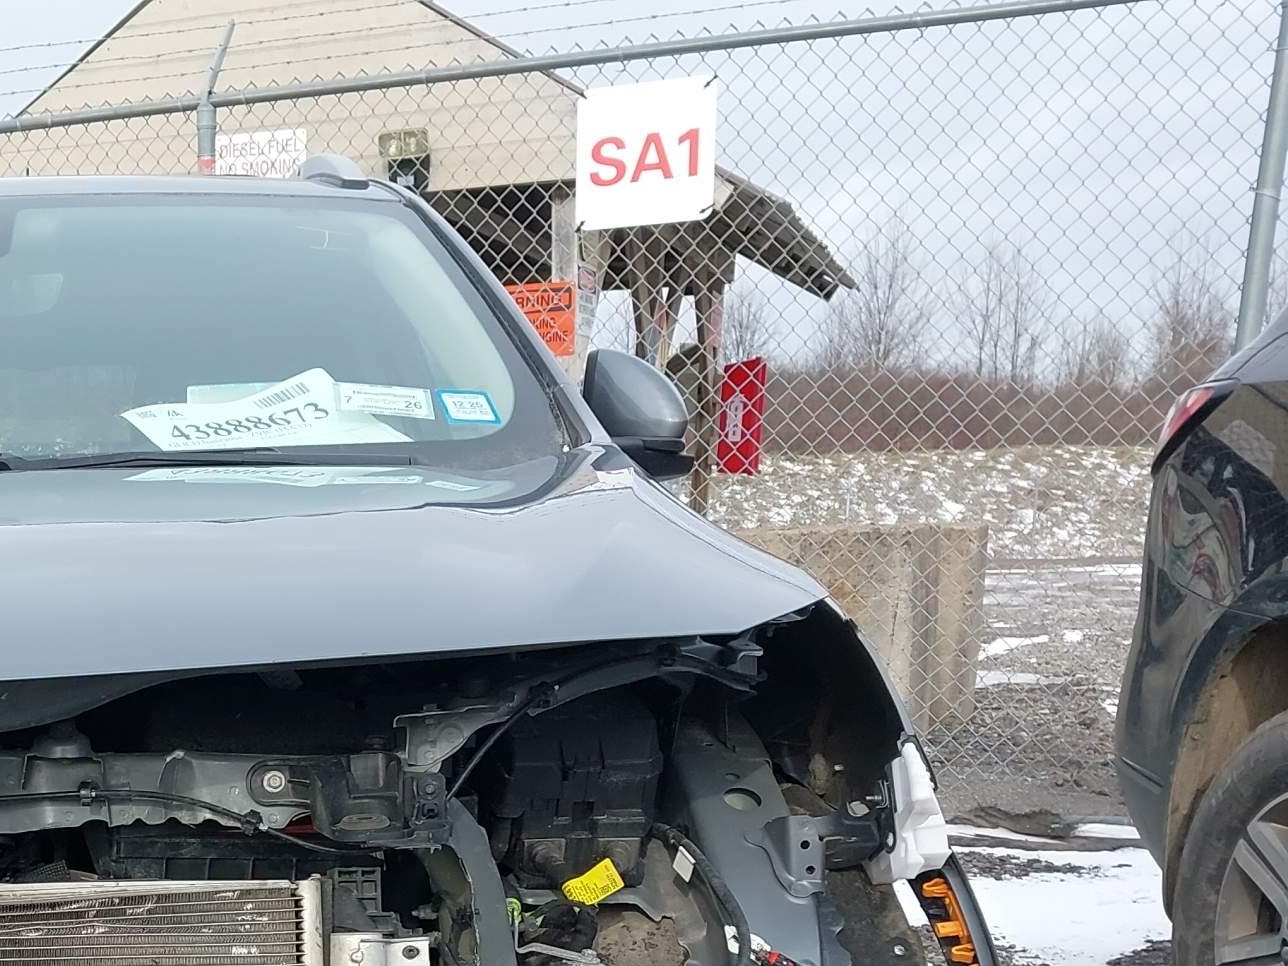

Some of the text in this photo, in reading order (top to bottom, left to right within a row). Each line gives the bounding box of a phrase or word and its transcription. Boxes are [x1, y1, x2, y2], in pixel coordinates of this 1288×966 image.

[268, 137, 302, 155] FUEL
[589, 127, 700, 187] SA1
[343, 395, 353, 404] 7
[404, 400, 423, 410] 26
[170, 402, 329, 441] 43888673
